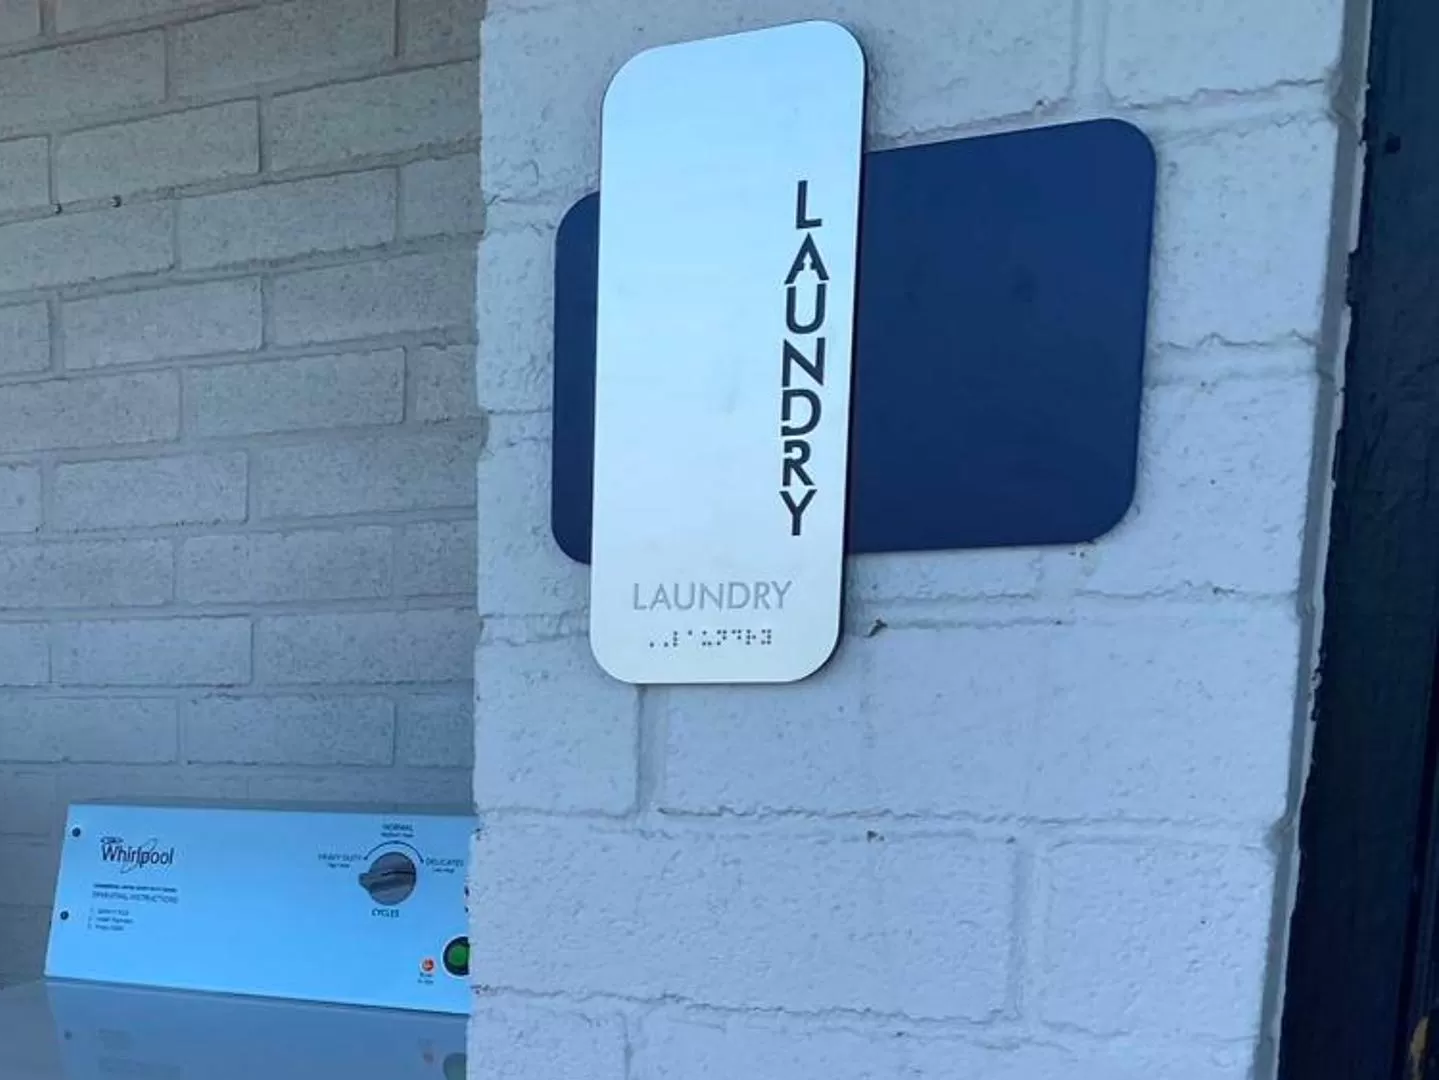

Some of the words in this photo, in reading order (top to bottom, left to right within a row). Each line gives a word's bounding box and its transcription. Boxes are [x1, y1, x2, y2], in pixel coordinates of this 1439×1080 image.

[779, 180, 829, 536] LAUNDRY
[633, 580, 793, 611] LAUNDRY
[101, 843, 175, 869] Whirlpool
